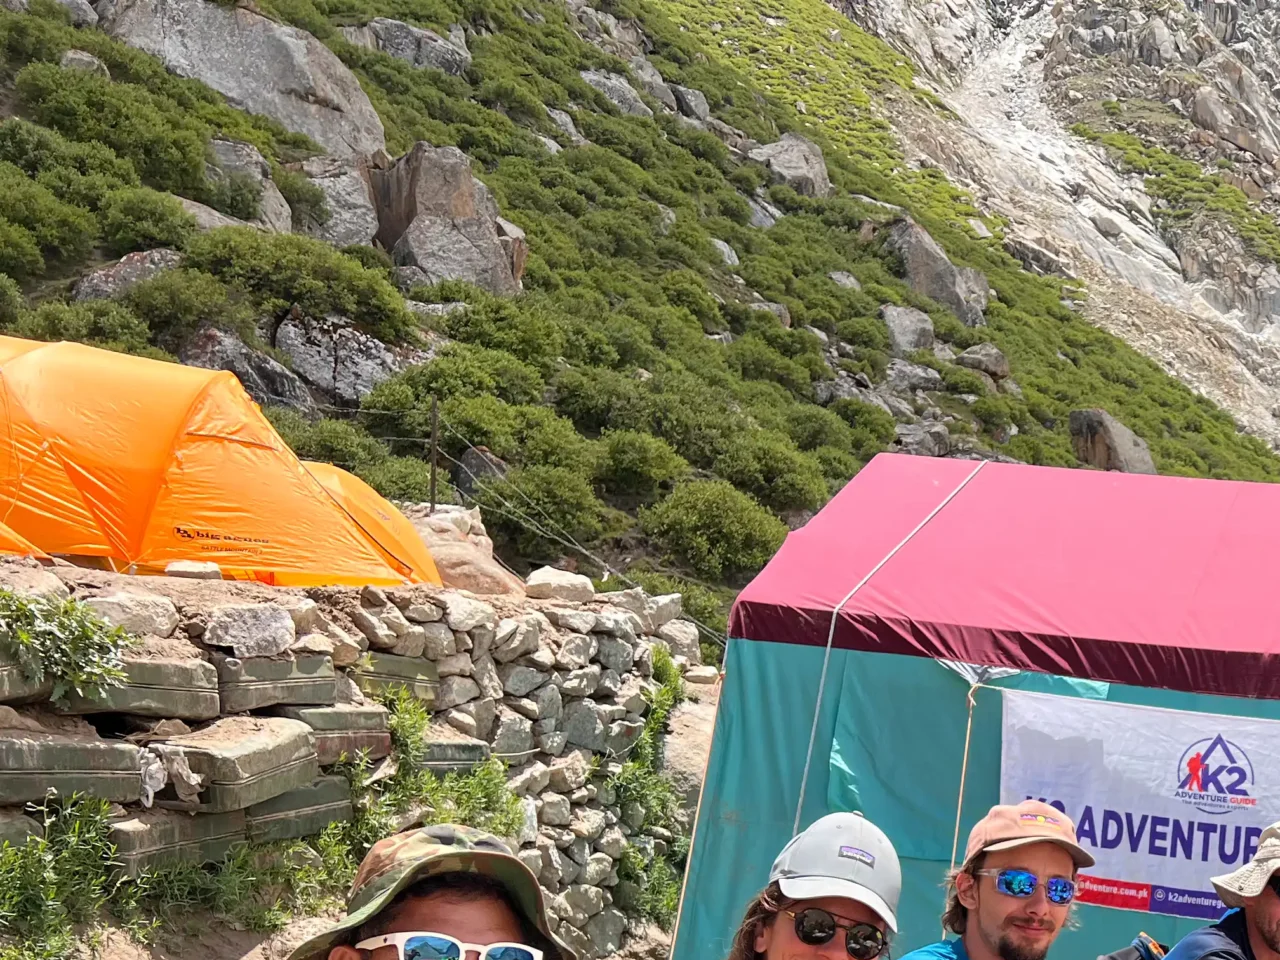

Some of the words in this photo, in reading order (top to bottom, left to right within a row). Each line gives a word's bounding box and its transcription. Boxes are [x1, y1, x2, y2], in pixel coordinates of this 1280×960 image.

[1175, 791, 1228, 803] ADVENTURE
[1229, 796, 1257, 806] GUIDE
[1076, 804, 1263, 866] ADVENTUR
[1080, 880, 1148, 899] adventure.com.pk
